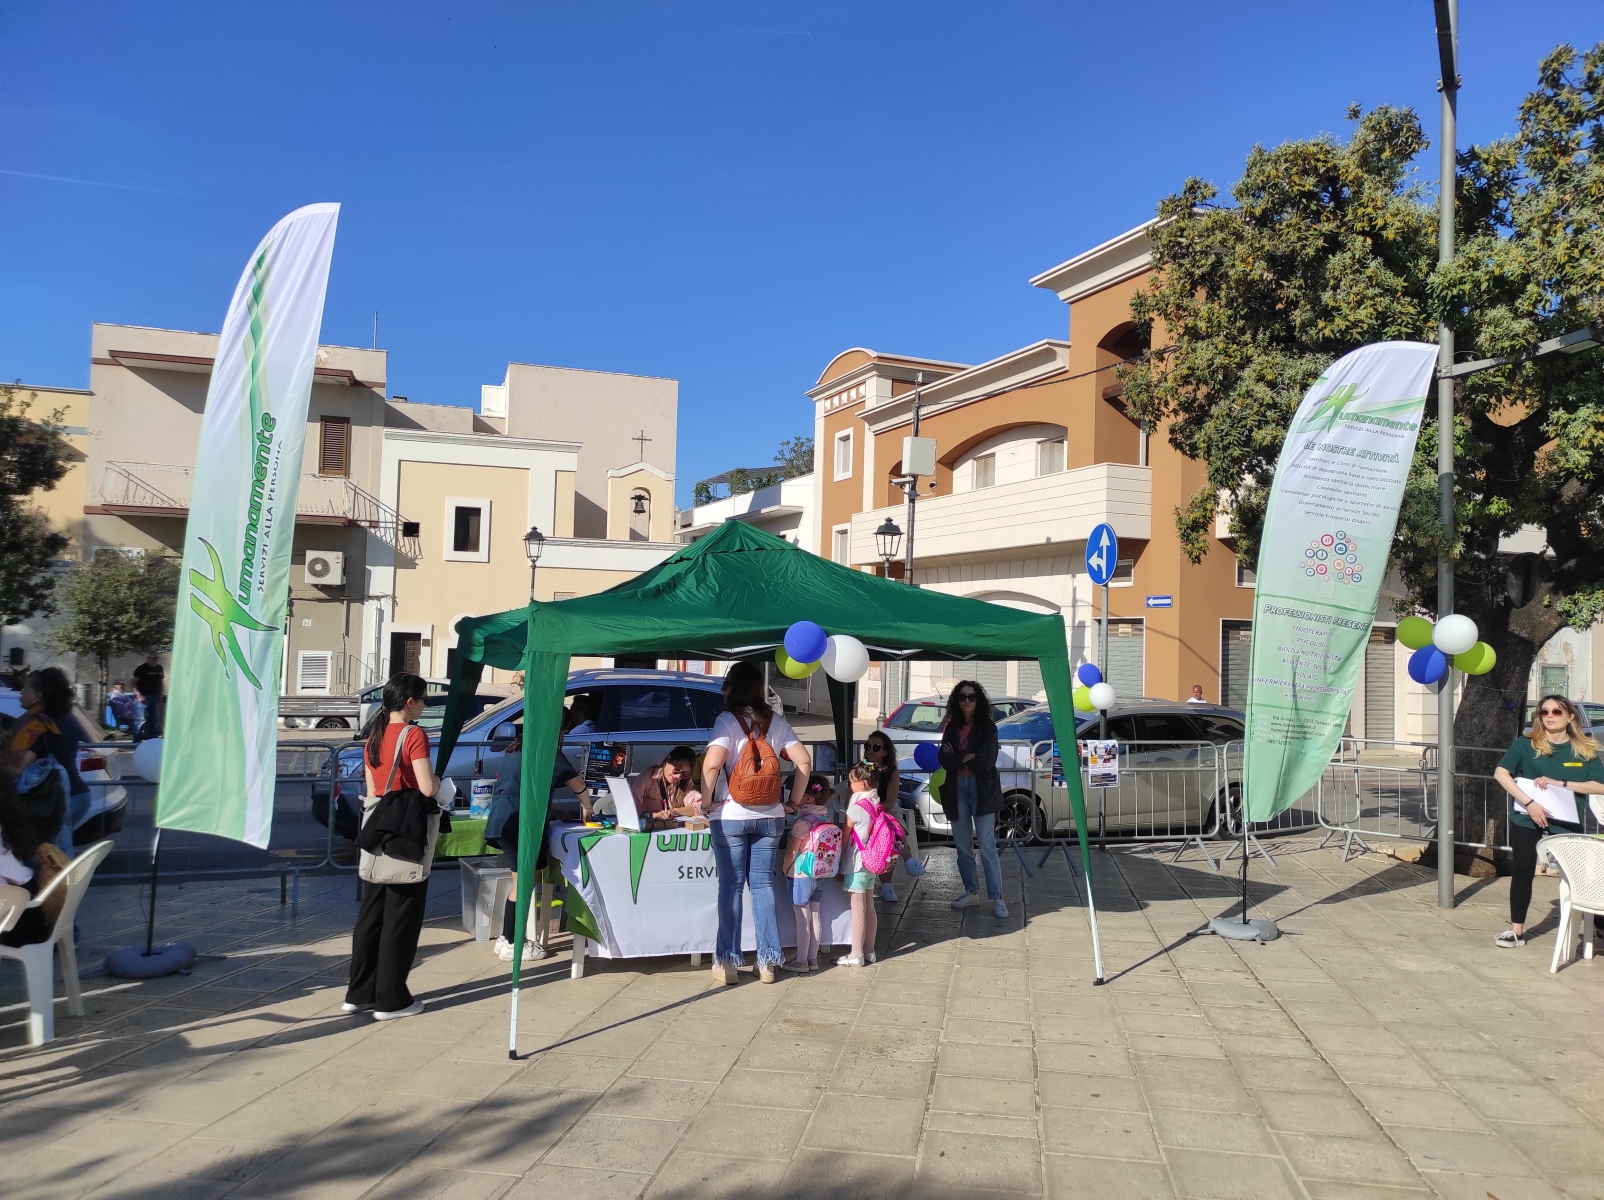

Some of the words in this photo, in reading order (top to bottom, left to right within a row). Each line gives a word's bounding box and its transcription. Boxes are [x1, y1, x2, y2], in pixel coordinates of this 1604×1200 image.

[1344, 424, 1364, 432] SERVIZI
[1380, 430, 1405, 438] PERSONA
[1304, 439, 1316, 450] LE
[1317, 442, 1356, 457] NOSTRE
[1356, 449, 1399, 463] ATTIVITÀ
[268, 440, 283, 502] PERSONA
[1358, 464, 1387, 473] formazione
[1303, 474, 1330, 482] Assistenza
[1331, 478, 1354, 486] sanitaria
[1355, 482, 1387, 491] domiciliare
[1317, 484, 1342, 493] Counselor
[1311, 493, 1343, 503] psicologiche
[1298, 500, 1334, 510] Orientamento
[264, 506, 273, 539] ALLA
[1304, 510, 1325, 518] Servizio
[1326, 513, 1350, 522] trasporto
[257, 544, 269, 592] SERVIZI
[1264, 604, 1332, 624] PROFESSIONISTI
[1296, 638, 1327, 648] PSICOLOGI
[1254, 677, 1291, 687] INFERMIERA
